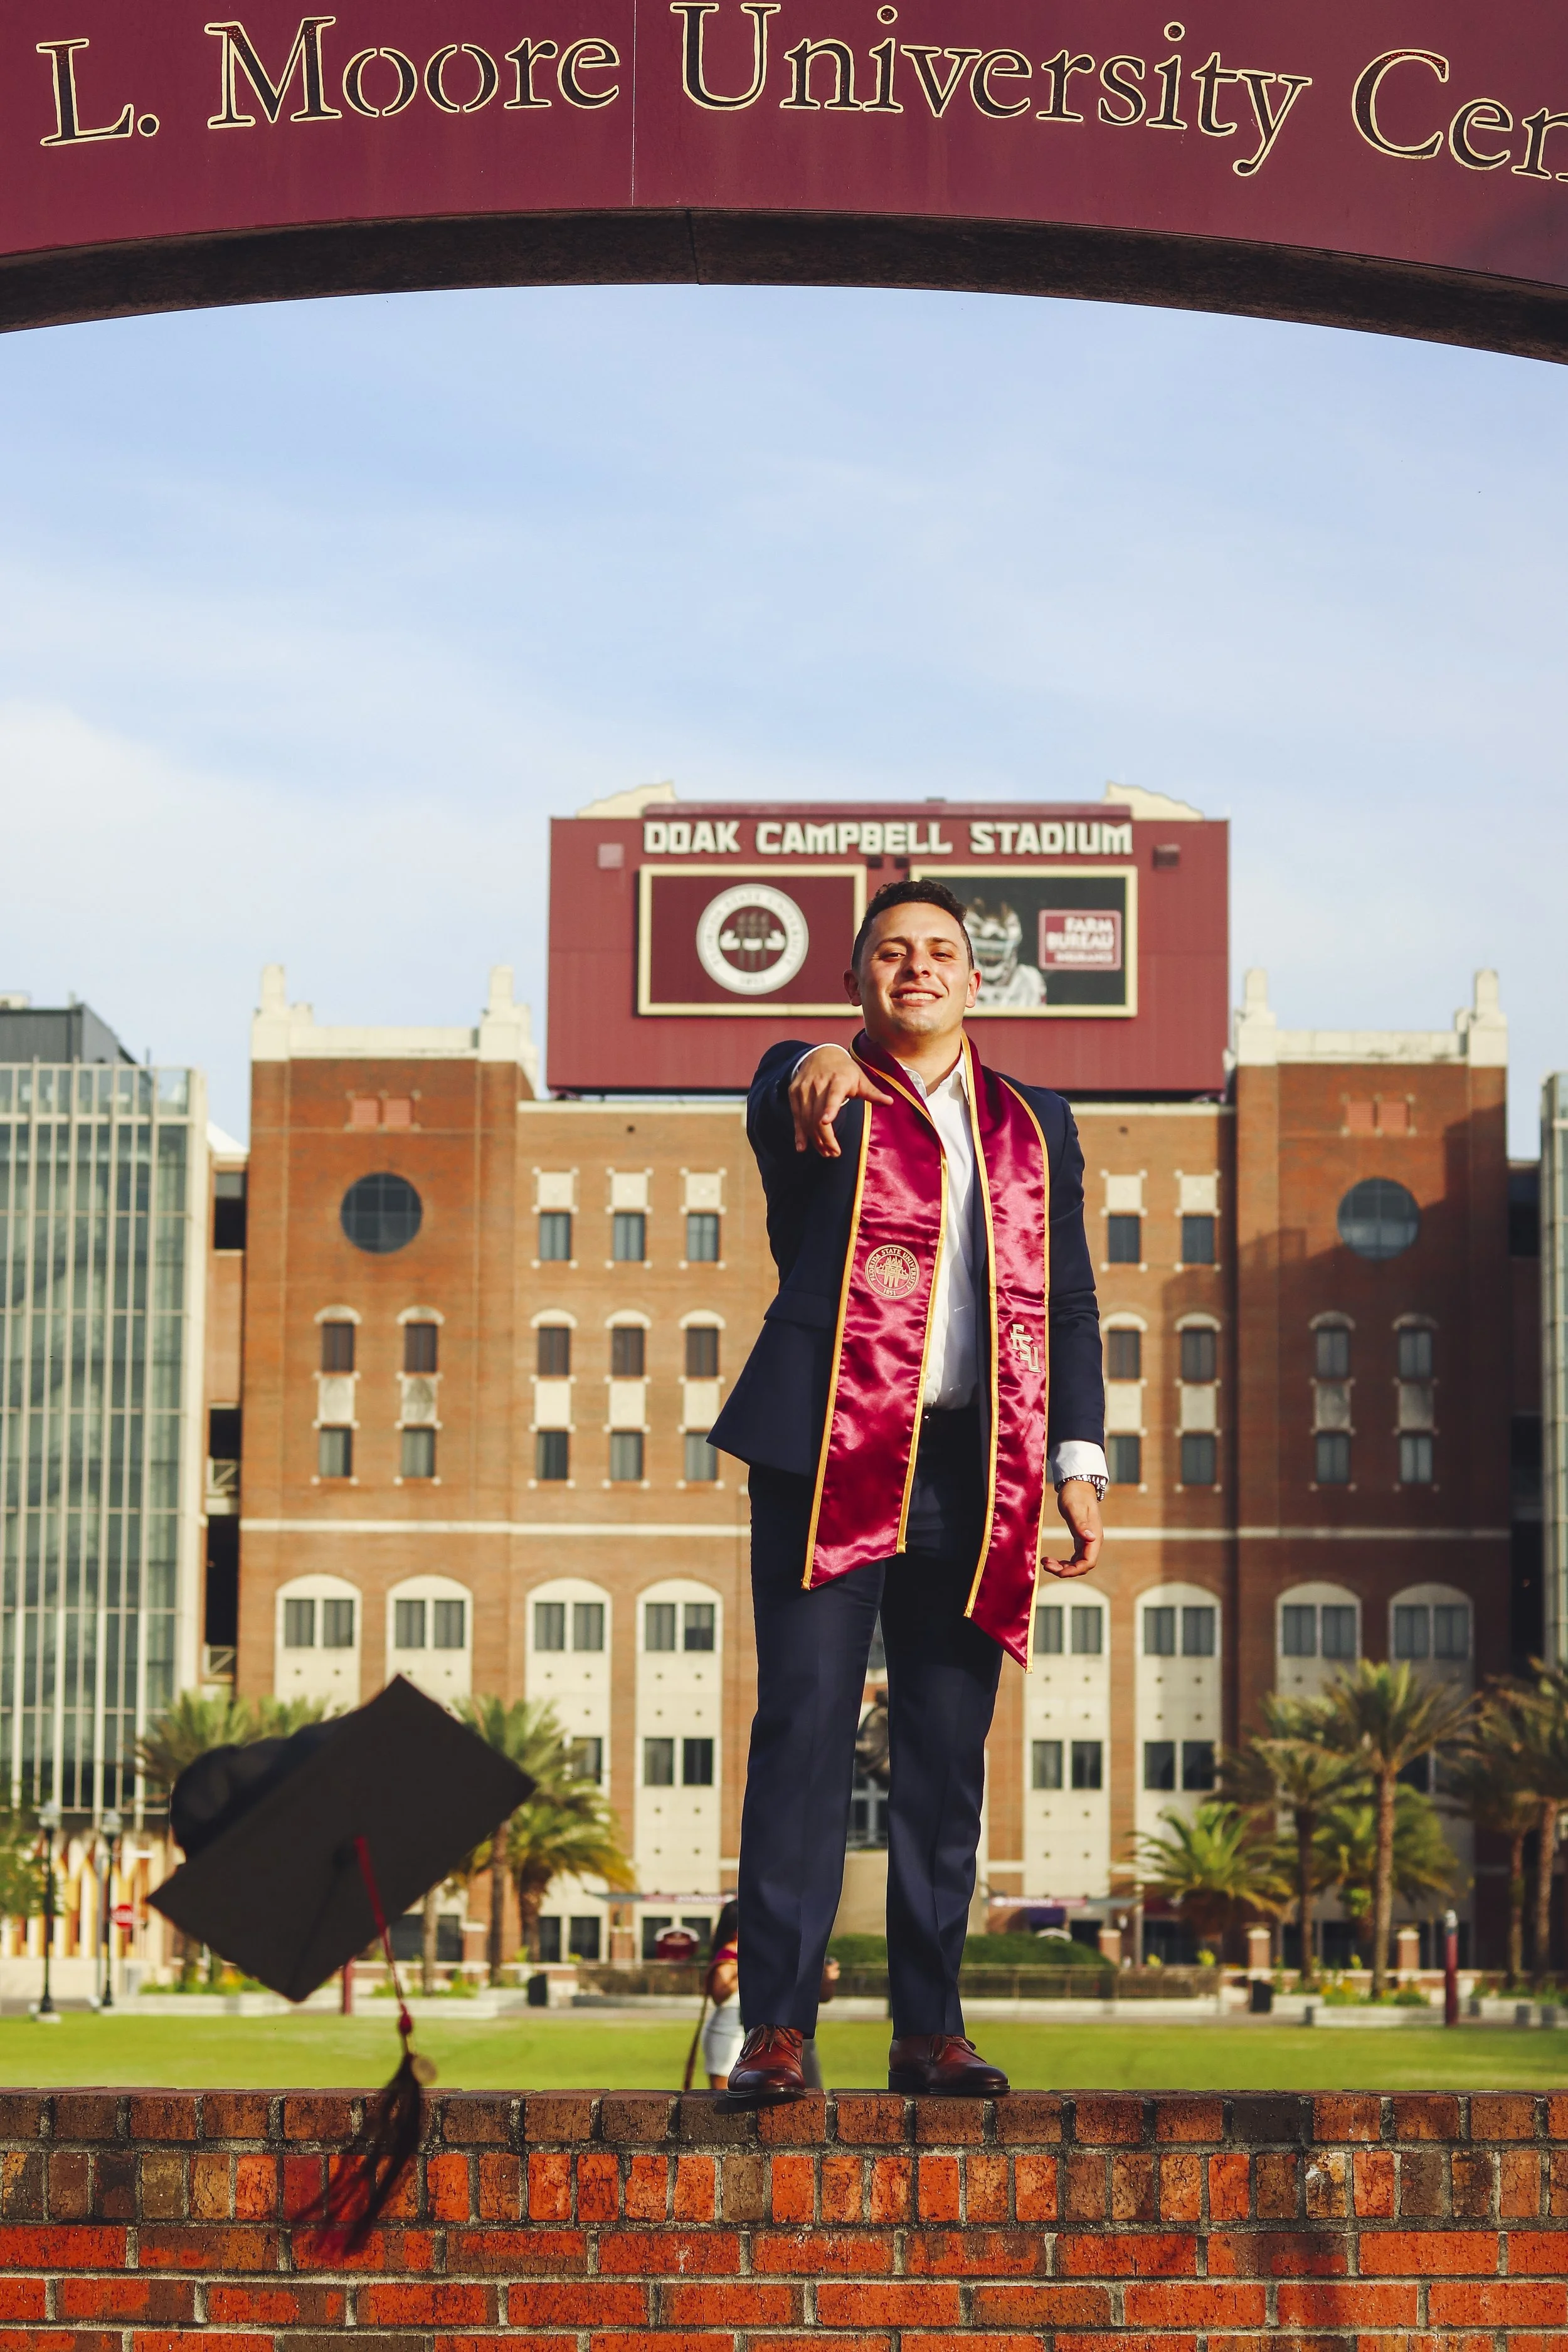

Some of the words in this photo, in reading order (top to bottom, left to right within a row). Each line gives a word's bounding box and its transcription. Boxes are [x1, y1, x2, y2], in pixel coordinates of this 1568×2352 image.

[36, 38, 160, 147] L.
[204, 16, 620, 129] Moore
[669, 2, 1313, 177] University
[1351, 48, 1568, 183] Cen
[644, 820, 741, 854] DOAK
[755, 821, 953, 855] CAMPBELL
[970, 821, 1133, 855] STADIUM
[869, 1253, 881, 1282] FLORIDA
[902, 1252, 916, 1291] UNIVERSITY
[883, 1288, 896, 1296] 1851
[1010, 1323, 1042, 1373] FSU
